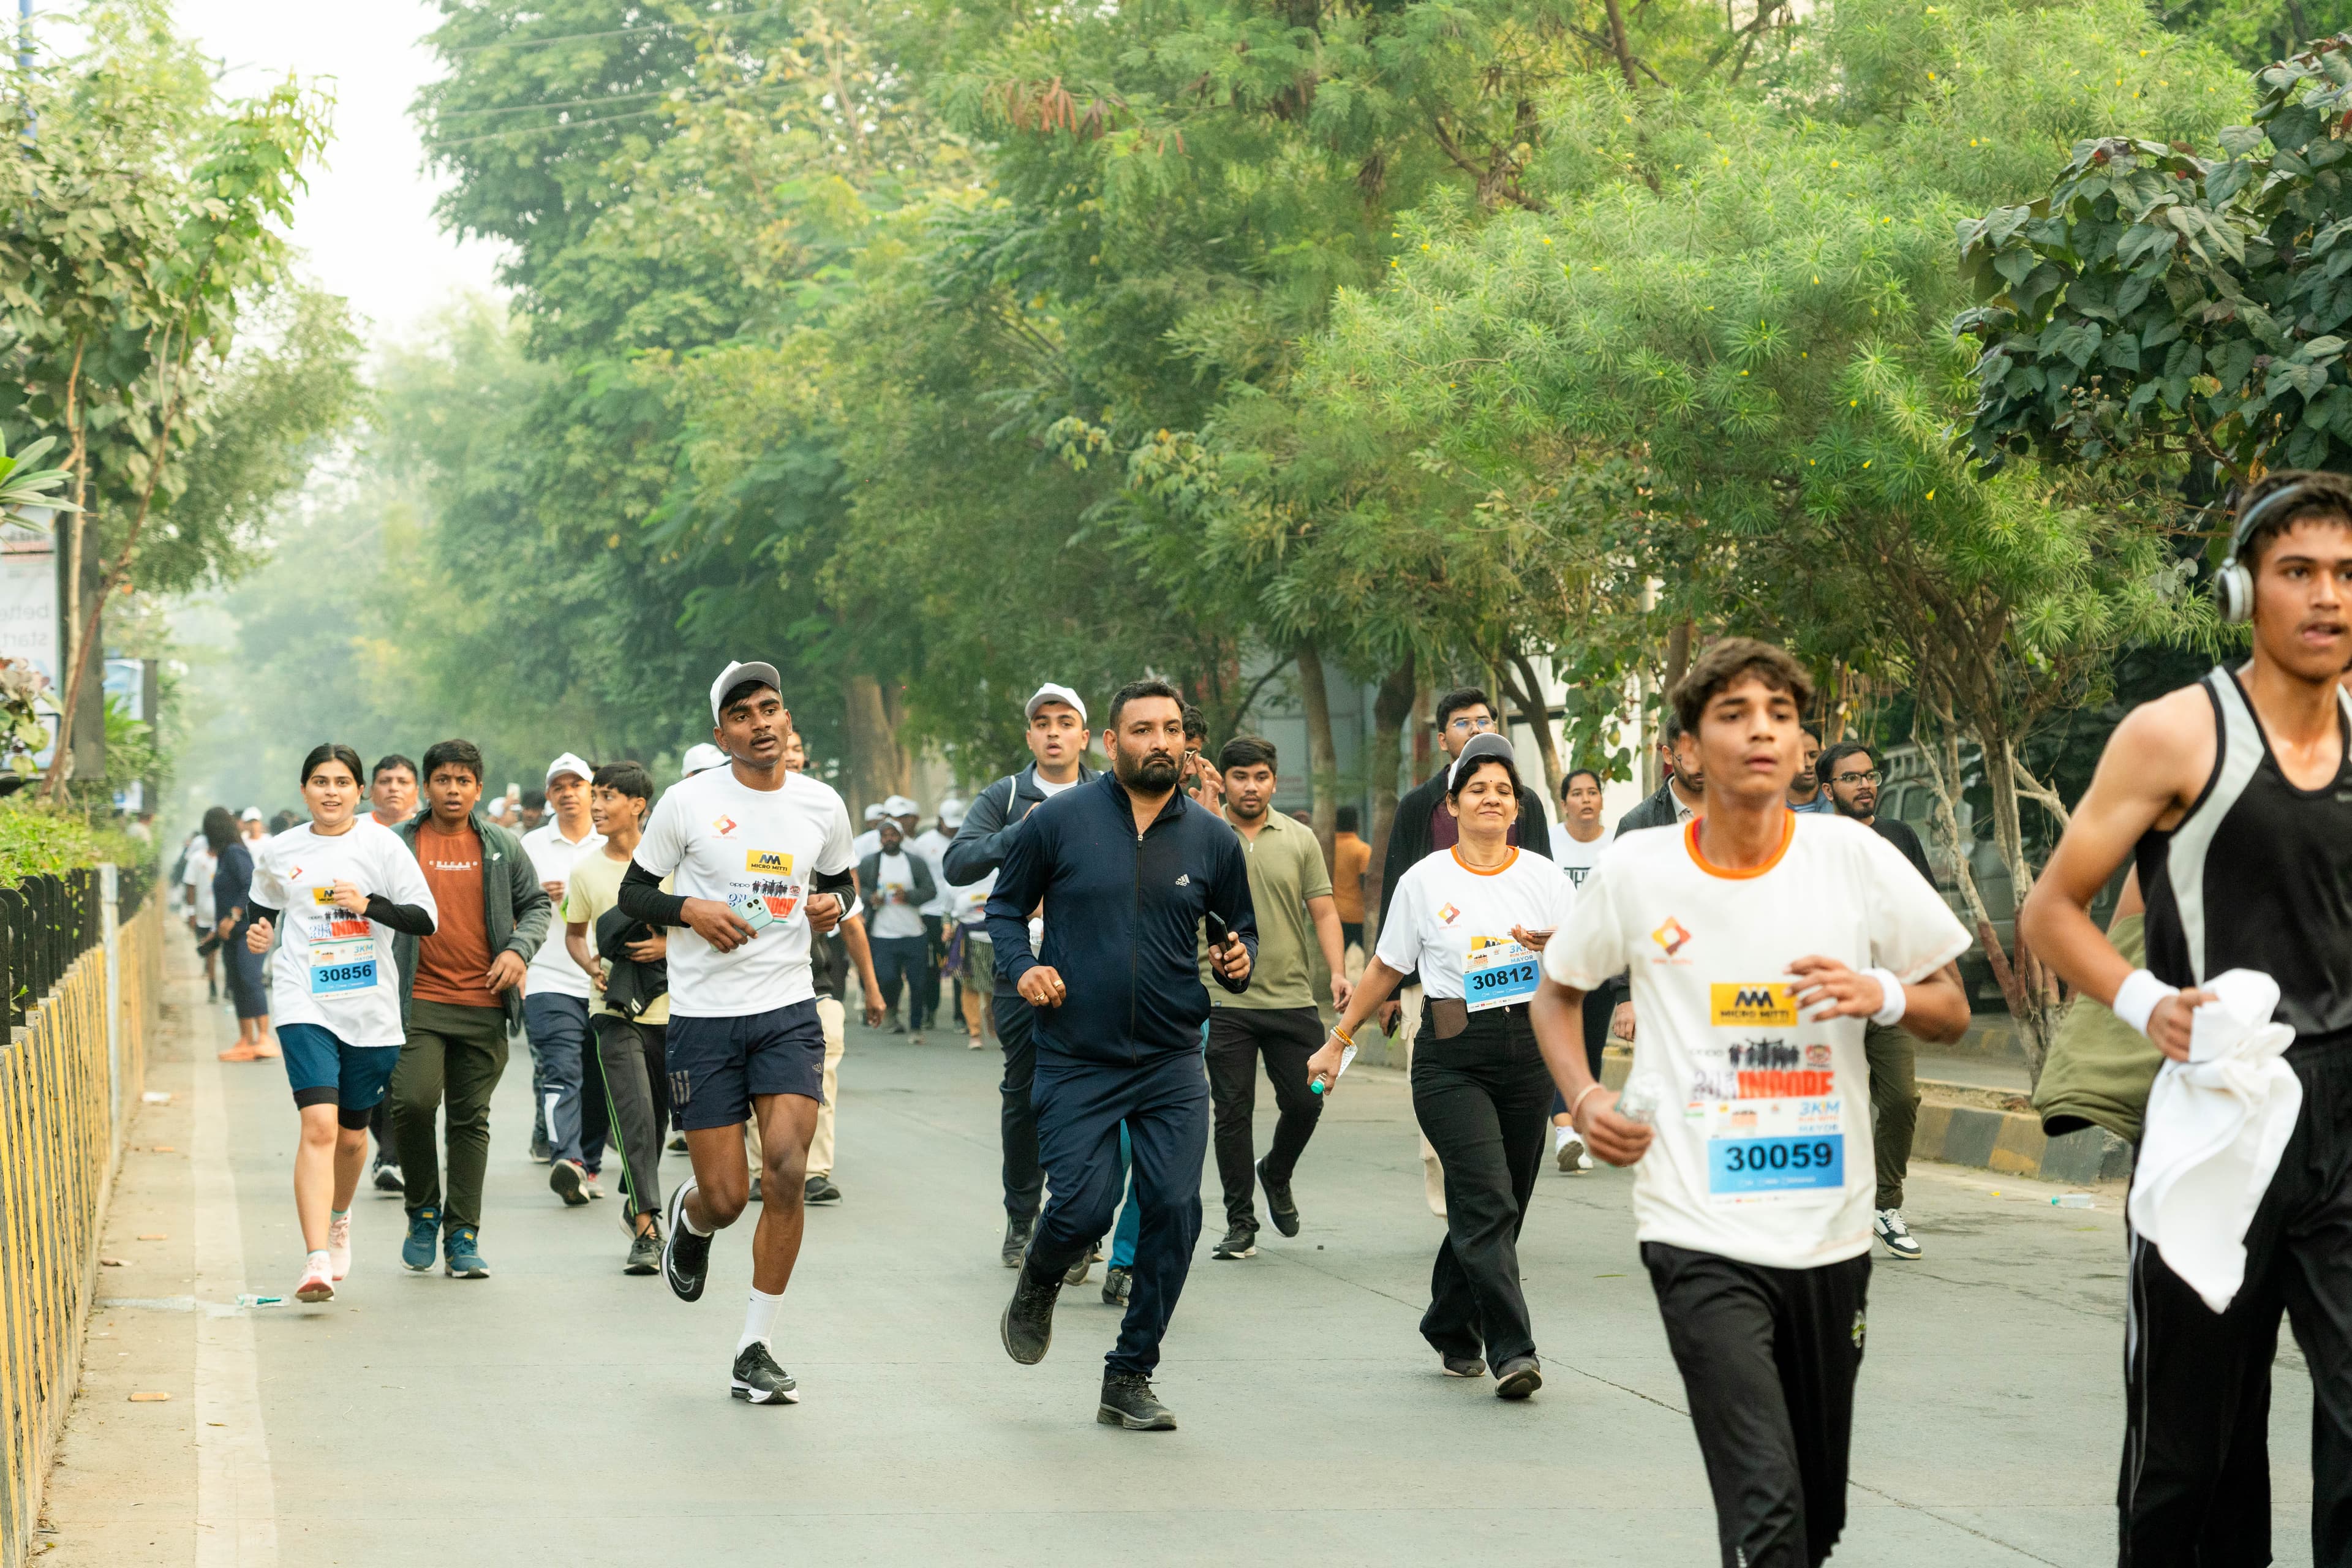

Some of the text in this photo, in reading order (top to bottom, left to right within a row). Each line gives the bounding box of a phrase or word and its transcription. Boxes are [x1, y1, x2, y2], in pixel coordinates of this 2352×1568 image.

[1564, 867, 1593, 891] TH
[1510, 955, 1533, 963] MAYOR
[319, 965, 372, 982] 30856
[1472, 966, 1534, 990] 30812
[1726, 1142, 1833, 1172] 30059
